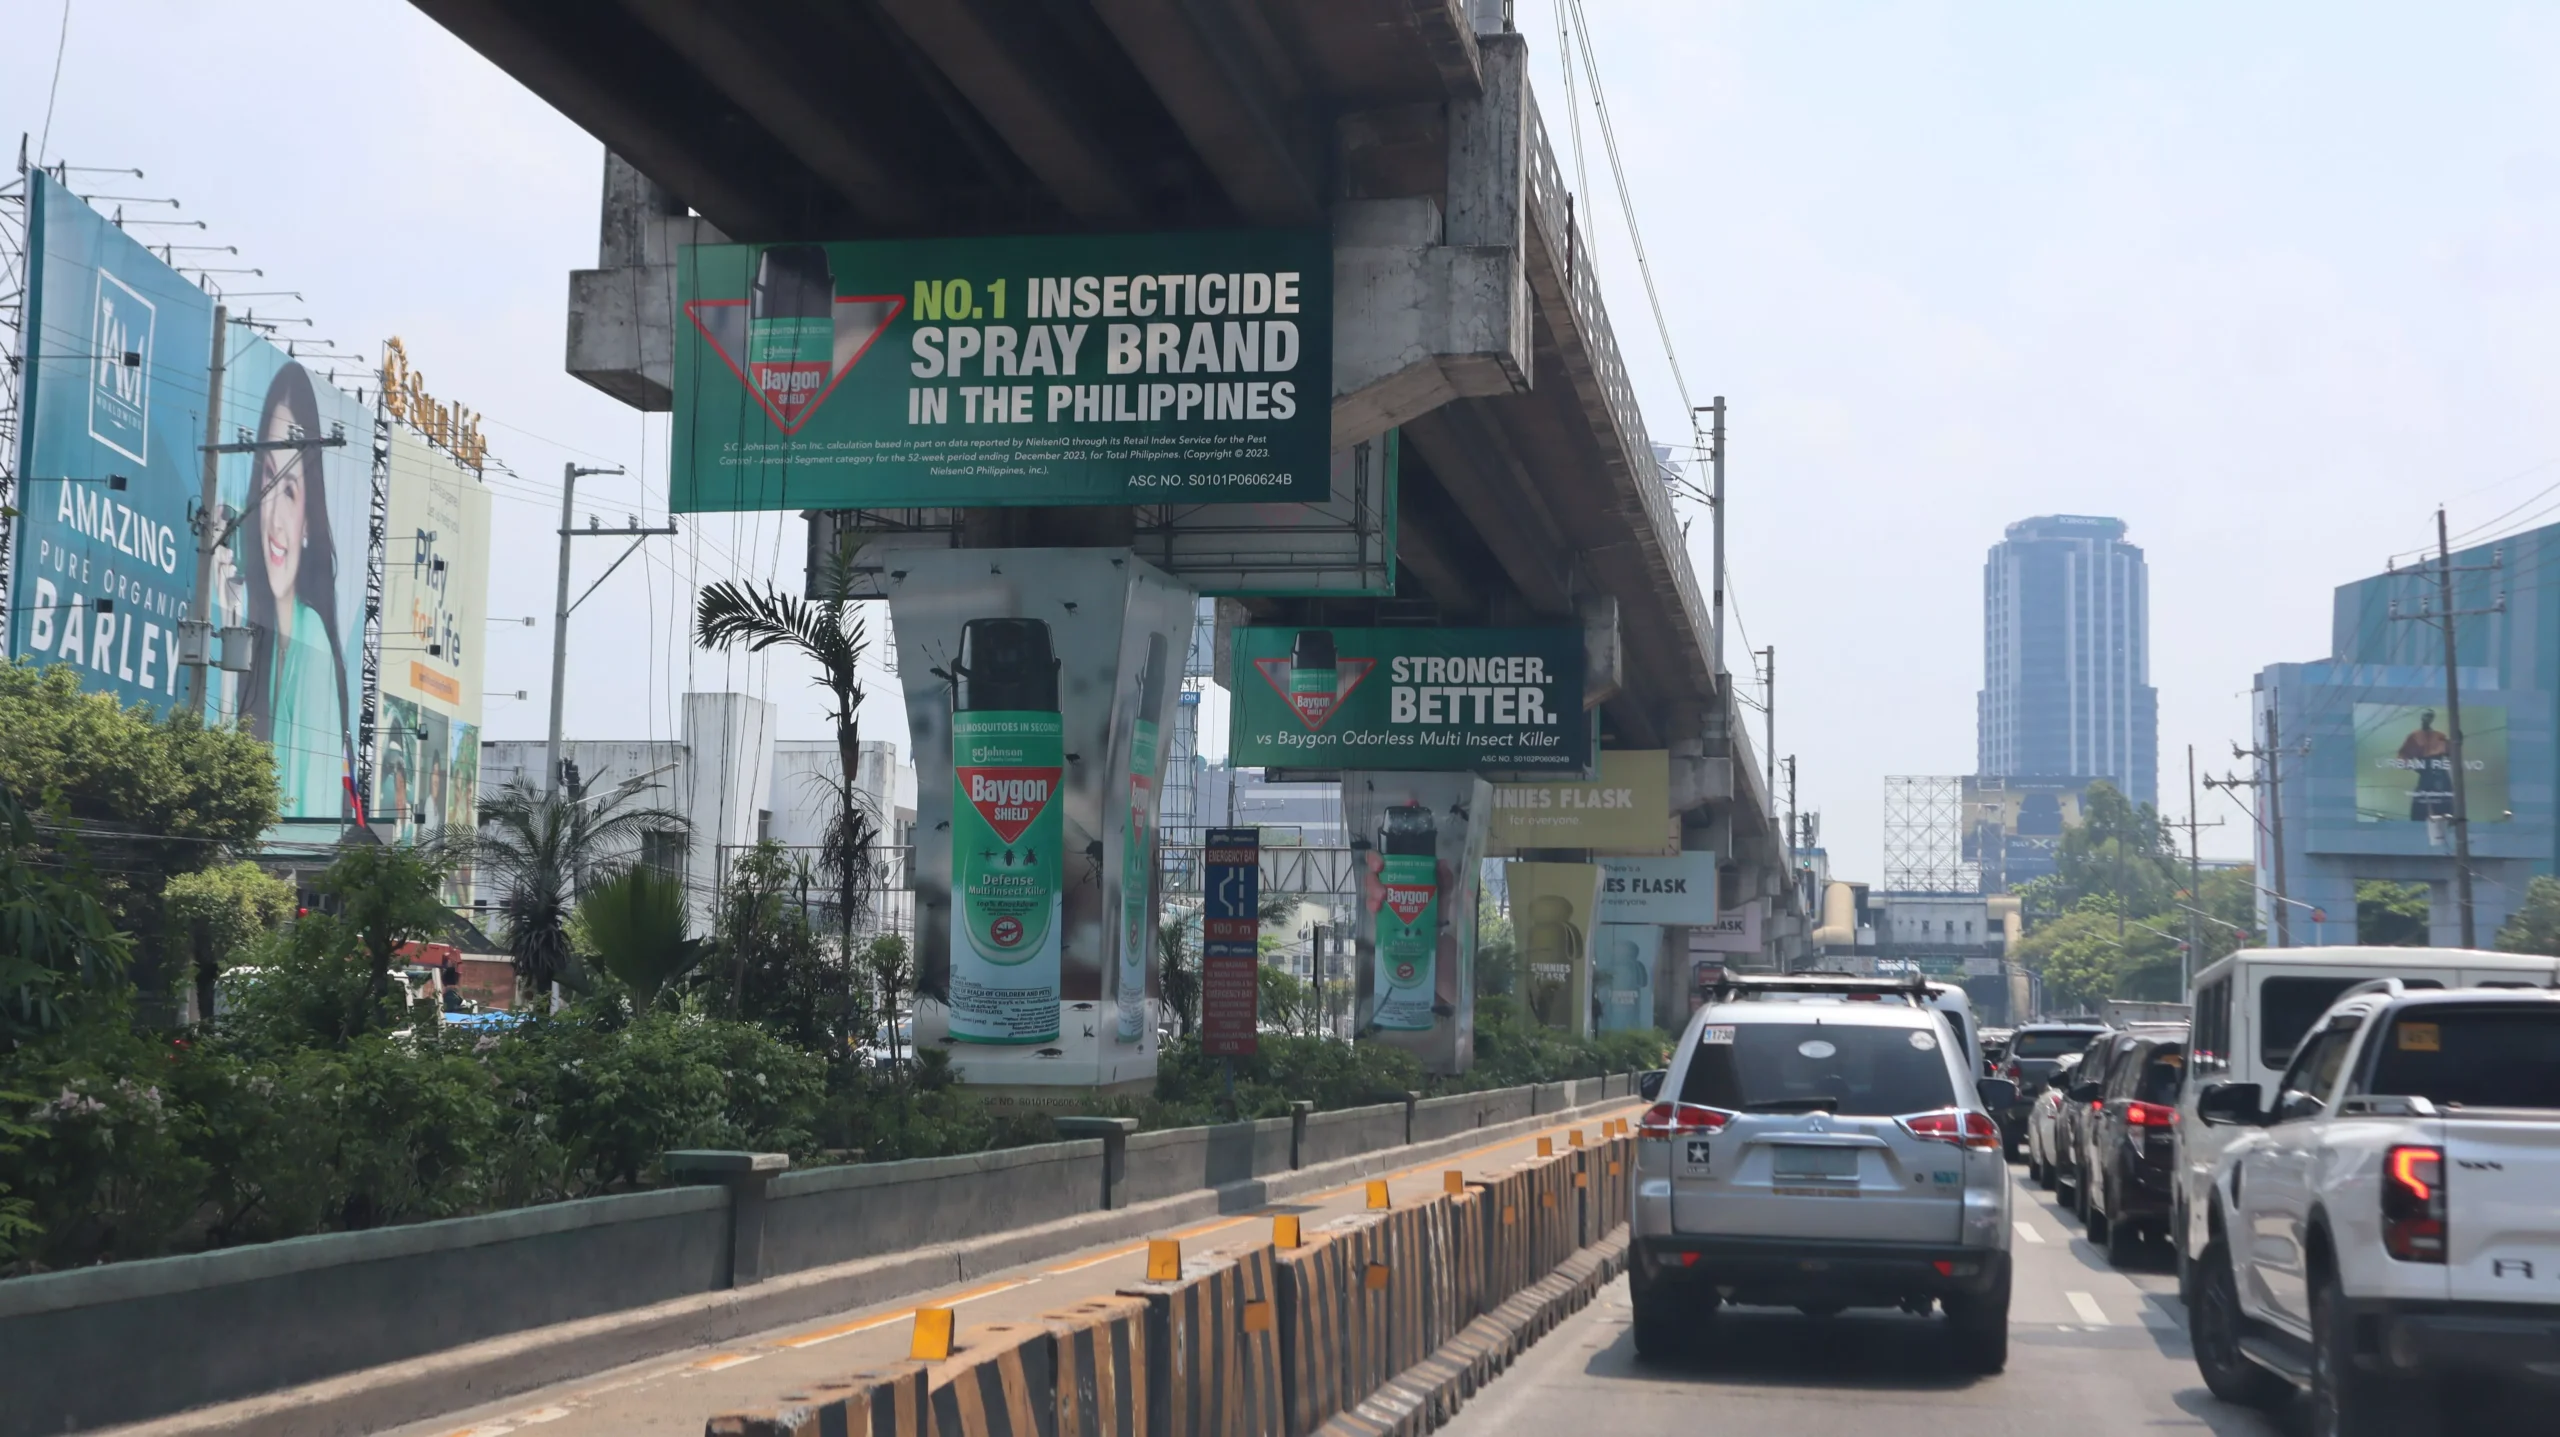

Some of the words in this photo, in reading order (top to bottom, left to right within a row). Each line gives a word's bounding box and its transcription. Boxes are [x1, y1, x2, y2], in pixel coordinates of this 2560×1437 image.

[913, 278, 1006, 320] NO.1
[1027, 272, 1300, 319] INSECTICIDE
[910, 324, 1089, 378] SPRAY
[1107, 320, 1300, 374] BRAND
[762, 368, 820, 391] Baygon
[908, 387, 948, 424] IN
[959, 386, 1033, 423] THE
[1047, 381, 1296, 423] PHILIPPINES
[410, 370, 448, 447] Sun
[453, 400, 487, 469] Life
[743, 441, 779, 451] Johnson
[791, 441, 807, 450] Son
[810, 441, 825, 450] Inc.
[827, 440, 872, 450] calculation
[875, 439, 901, 449] based
[904, 440, 912, 448] in
[914, 439, 932, 450] part
[948, 438, 968, 446] data
[971, 437, 1010, 449] reported
[1012, 438, 1023, 448] by
[1026, 437, 1070, 446] NielsenIQ
[1072, 436, 1107, 448] through
[1110, 437, 1121, 445] its
[1123, 436, 1149, 445] Retail
[1151, 436, 1176, 445] Index
[1179, 435, 1212, 445] Service
[1213, 435, 1227, 444] for
[1229, 435, 1245, 444] the
[1247, 435, 1267, 444] Pest
[795, 455, 833, 466] Segment
[836, 454, 874, 464] category
[876, 454, 888, 463] for
[891, 454, 906, 463] the
[908, 453, 945, 462] 52-week
[947, 452, 977, 463] period
[979, 452, 1010, 463] ending
[1014, 451, 1061, 461] December
[1063, 451, 1088, 461] 2023,
[1090, 451, 1103, 460] for
[1106, 450, 1127, 460] Total
[1130, 450, 1181, 462] Philippines.
[1183, 449, 1232, 461] (Copyright
[1245, 449, 1270, 458] 2023.
[930, 466, 974, 476] NielsenIQ
[976, 465, 1026, 477] Philippines,
[1028, 465, 1049, 475] inc.).
[1128, 475, 1157, 487] ASC
[1160, 475, 1184, 486] NO.
[1188, 473, 1293, 486] S0101P060624B
[58, 476, 176, 574] AMAZING
[40, 539, 90, 584] PURE
[104, 569, 188, 621] ORGANIC
[30, 576, 179, 697] BARLEY
[1391, 656, 1553, 684] STRONGER.
[1391, 686, 1557, 724] BETTER.
[967, 722, 1018, 733] MOSQUITOES
[1020, 722, 1029, 732] IN
[1256, 734, 1272, 746] vs
[1278, 731, 1337, 749] Baygon
[1342, 730, 1414, 746] Odorless
[1420, 730, 1461, 746] Multi
[1466, 731, 1513, 746] Insect
[1519, 731, 1560, 747] Killer
[1481, 755, 1497, 763] ASC
[1499, 755, 1512, 763] NO.
[2374, 758, 2426, 770] URBAN
[972, 775, 1048, 806] Baygon
[1560, 788, 1633, 809] FLASK
[994, 807, 1029, 821] SHIELD
[1528, 817, 1582, 827] everyone.
[1209, 849, 1242, 863] EMERGENCY
[1244, 849, 1256, 863] BAY
[983, 874, 1034, 886] Defense
[1632, 878, 1687, 894] FLASK
[969, 886, 990, 896] Multi
[993, 886, 1022, 896] Insect
[1025, 886, 1046, 896] Killer
[1387, 887, 1429, 905] Baygon
[1213, 923, 1232, 935] 100
[1239, 925, 1251, 935] m
[995, 990, 1026, 998] CHILDREN
